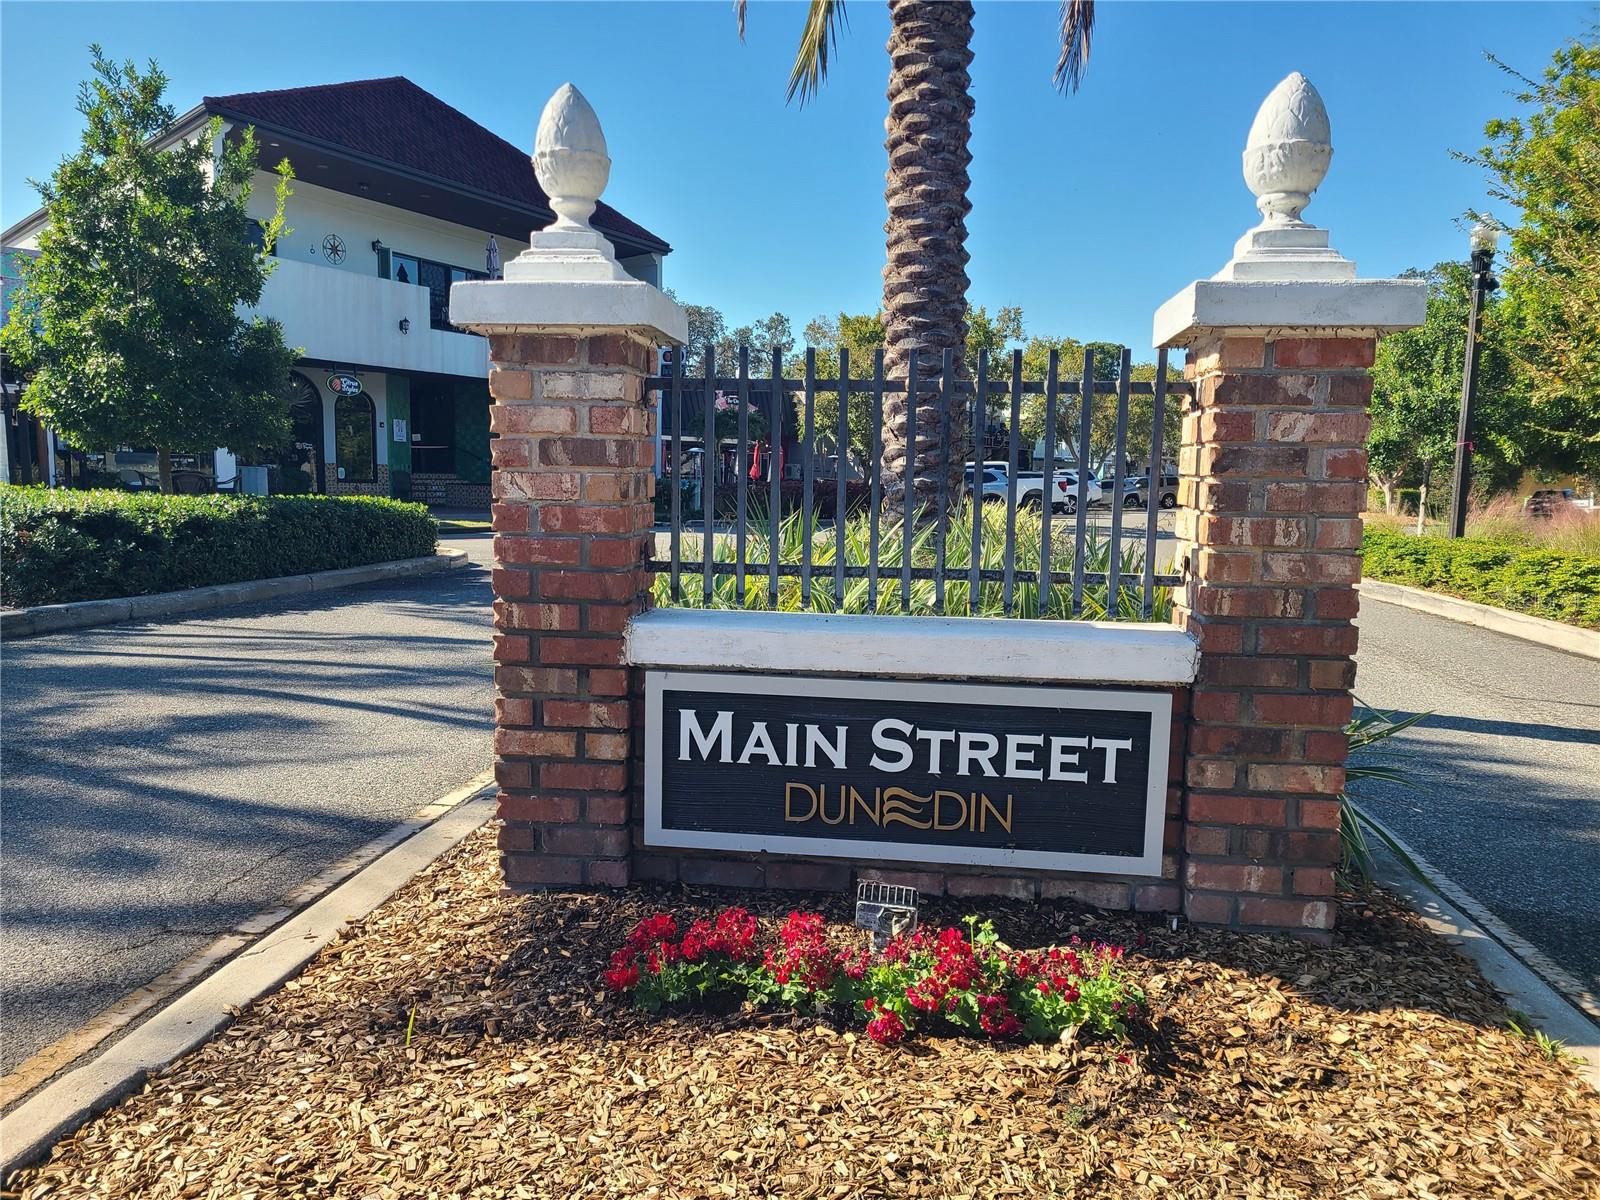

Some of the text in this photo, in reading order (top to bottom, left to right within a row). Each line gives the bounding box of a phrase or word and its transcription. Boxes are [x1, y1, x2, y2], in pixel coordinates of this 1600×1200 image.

[341, 377, 358, 387] Citrus
[678, 709, 1133, 784] MAIN STREET
[784, 782, 1014, 834] DUNEDIN
